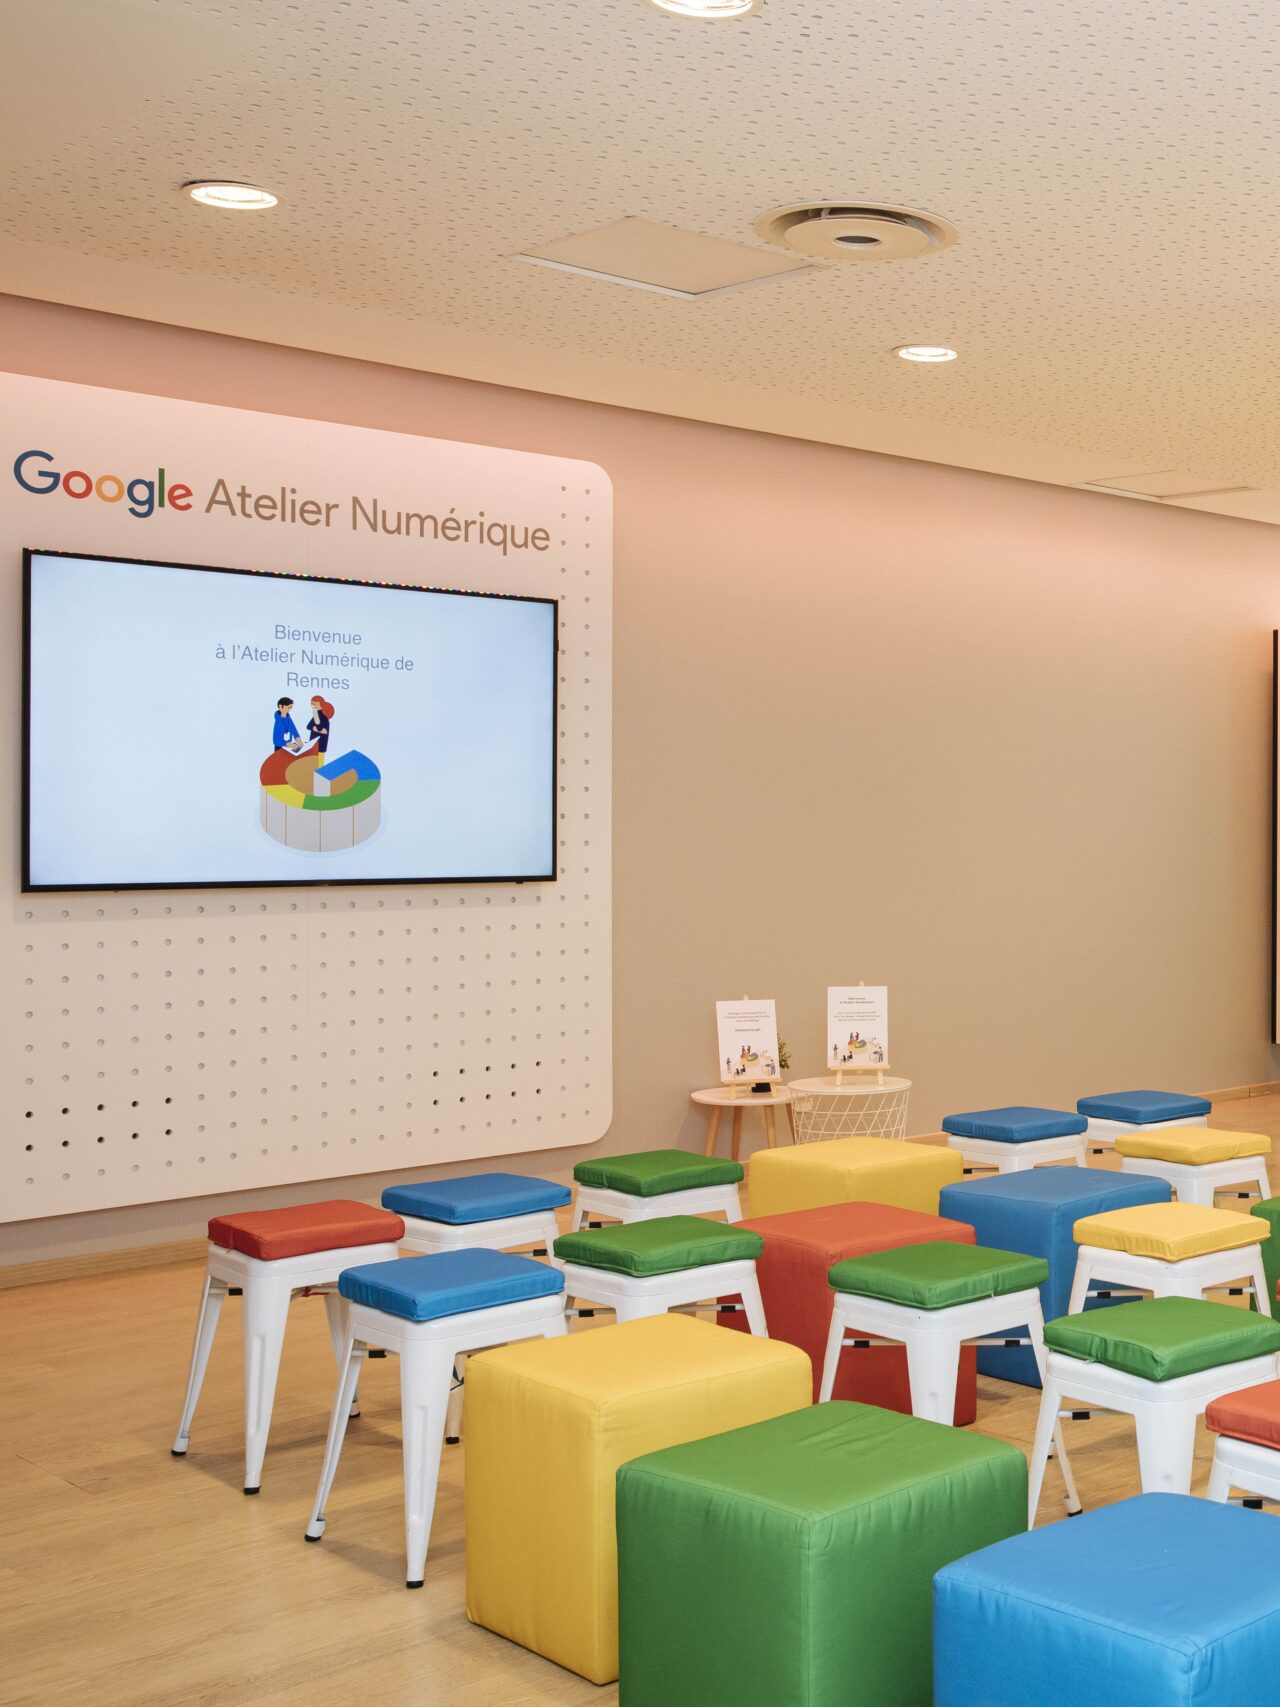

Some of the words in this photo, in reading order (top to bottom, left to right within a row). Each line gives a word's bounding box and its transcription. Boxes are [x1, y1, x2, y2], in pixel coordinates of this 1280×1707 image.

[13, 450, 193, 518] Google
[205, 478, 339, 527] Atelier
[352, 496, 550, 556] Numérique
[274, 625, 362, 645] Bienvenue
[215, 643, 226, 659] à
[301, 649, 390, 671] Numérique
[394, 656, 414, 671] de
[286, 672, 350, 690] Rennes
